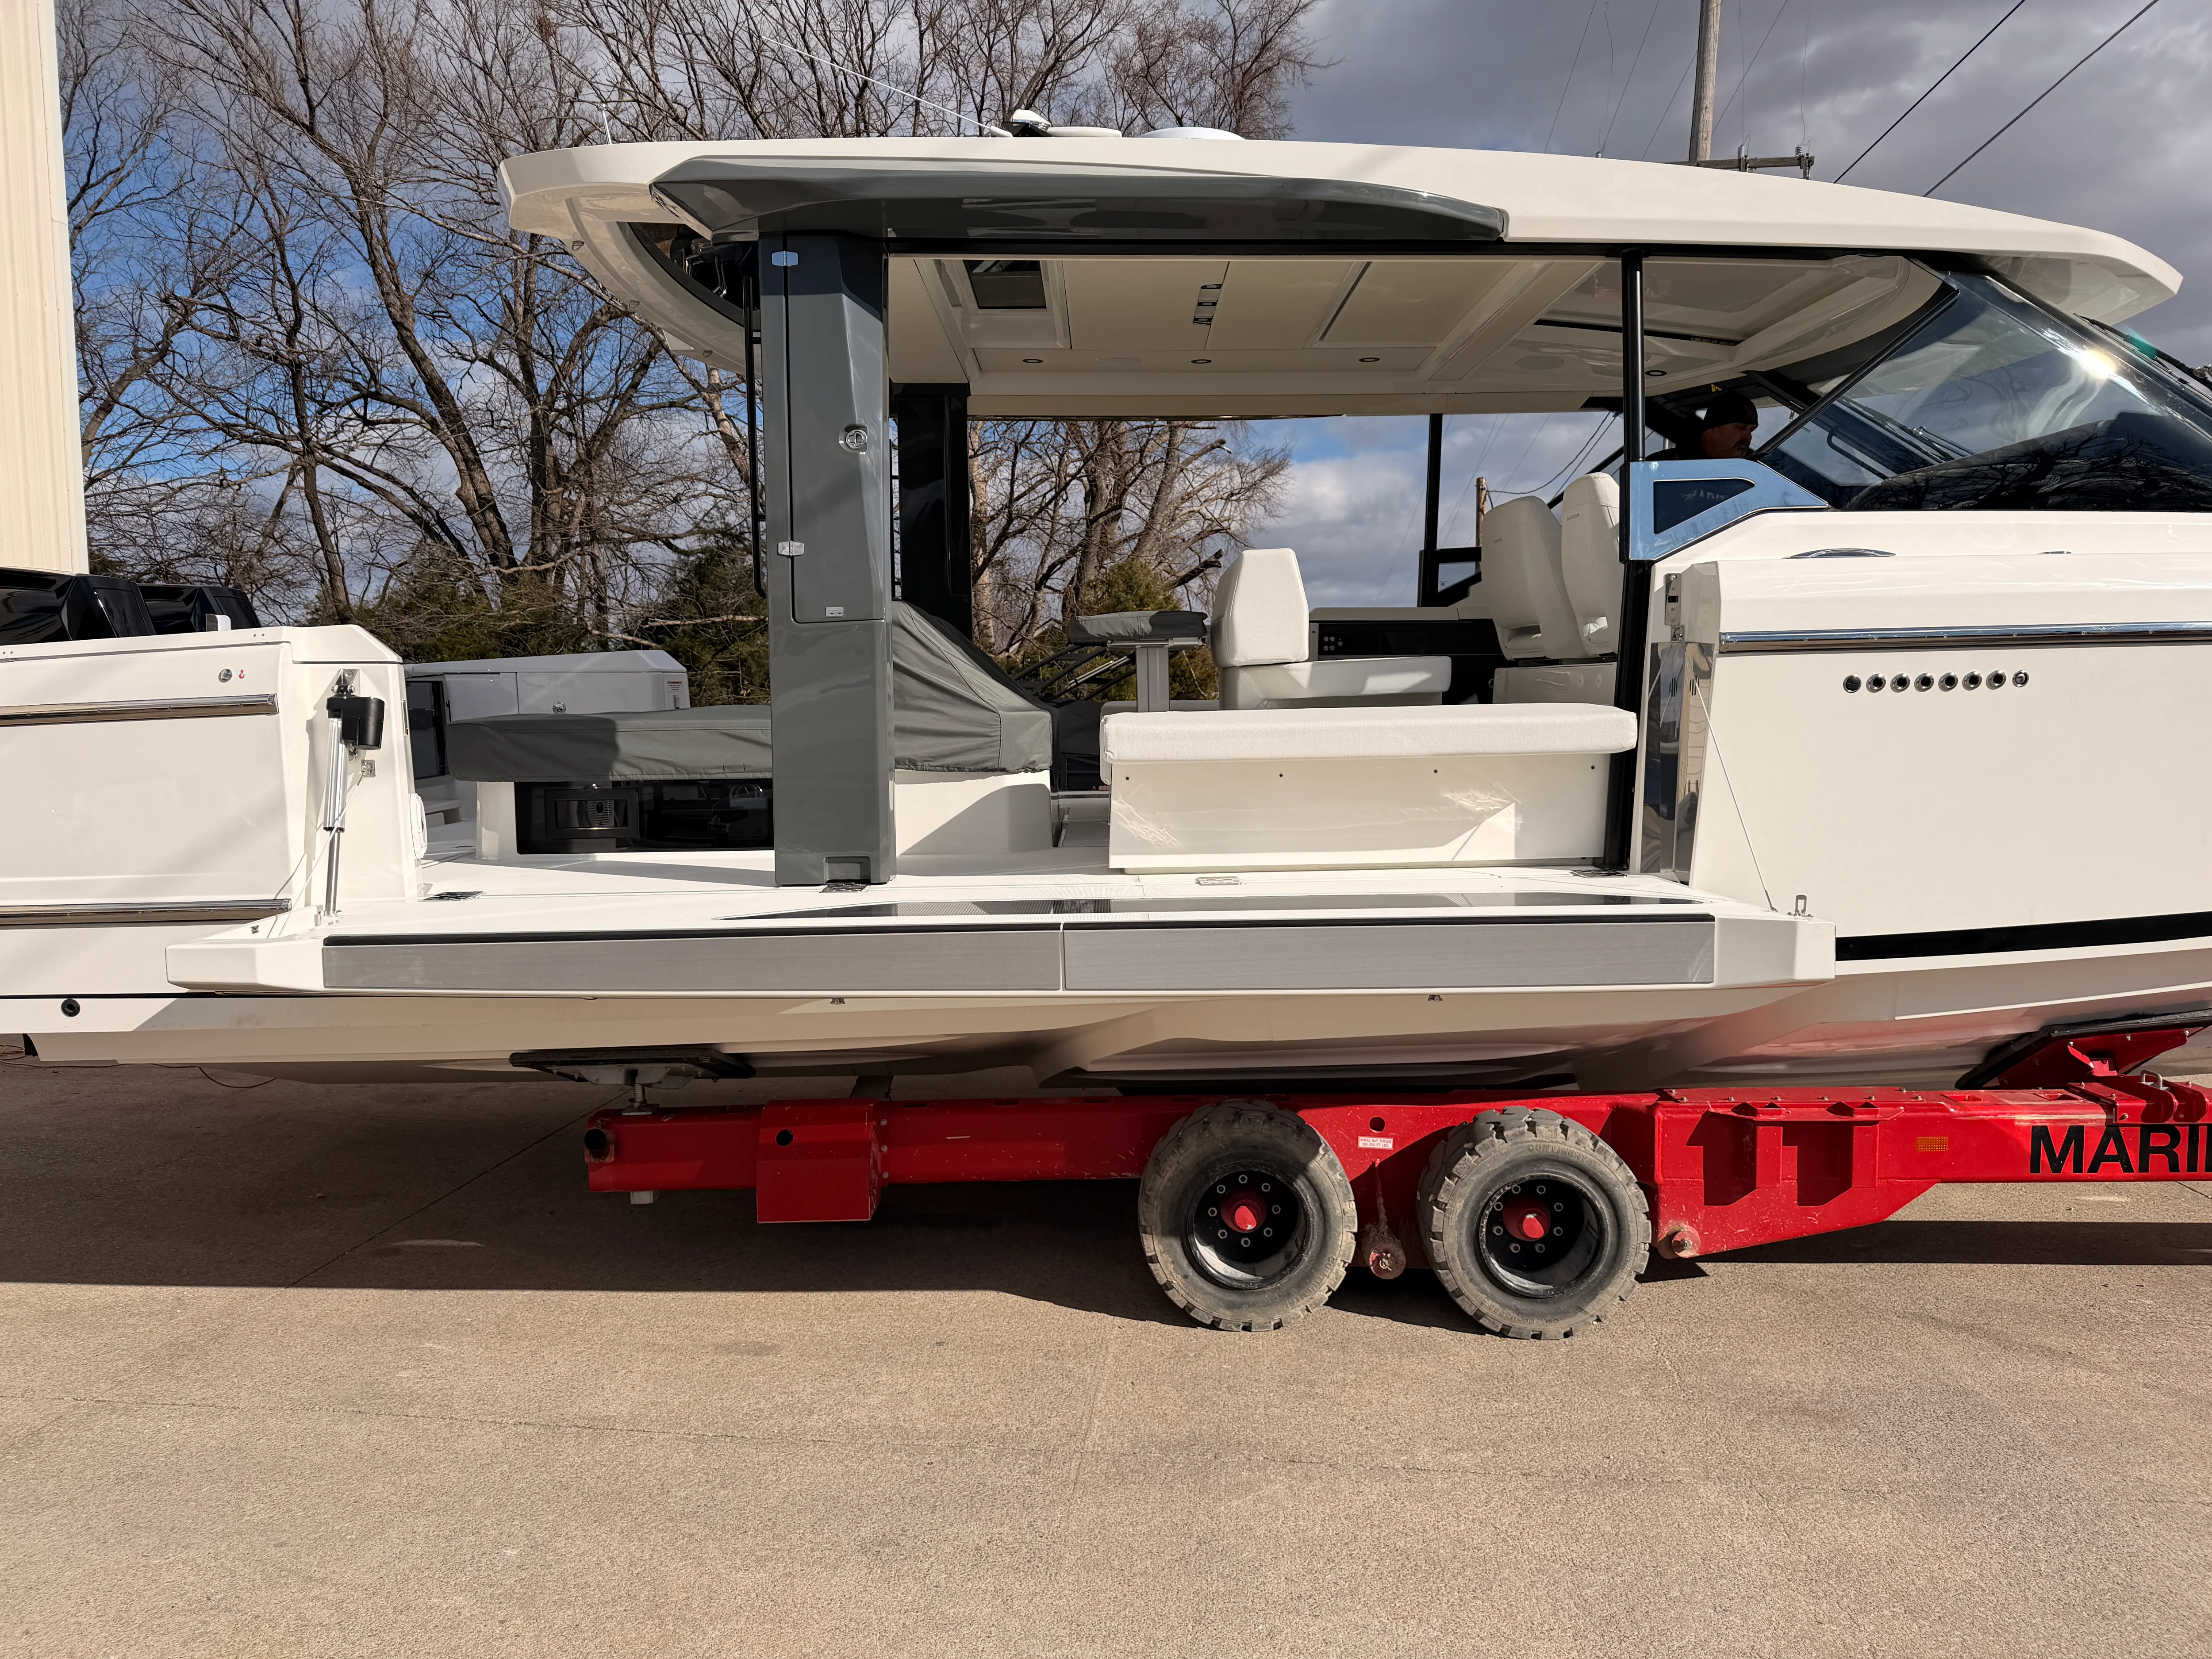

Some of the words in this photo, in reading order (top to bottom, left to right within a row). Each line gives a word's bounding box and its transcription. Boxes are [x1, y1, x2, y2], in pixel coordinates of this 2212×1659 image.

[1527, 1144, 1598, 1170] CONTINENTAL
[2029, 1125, 2212, 1174] MARI
[1285, 1256, 1336, 1310] CONTINENTAL
